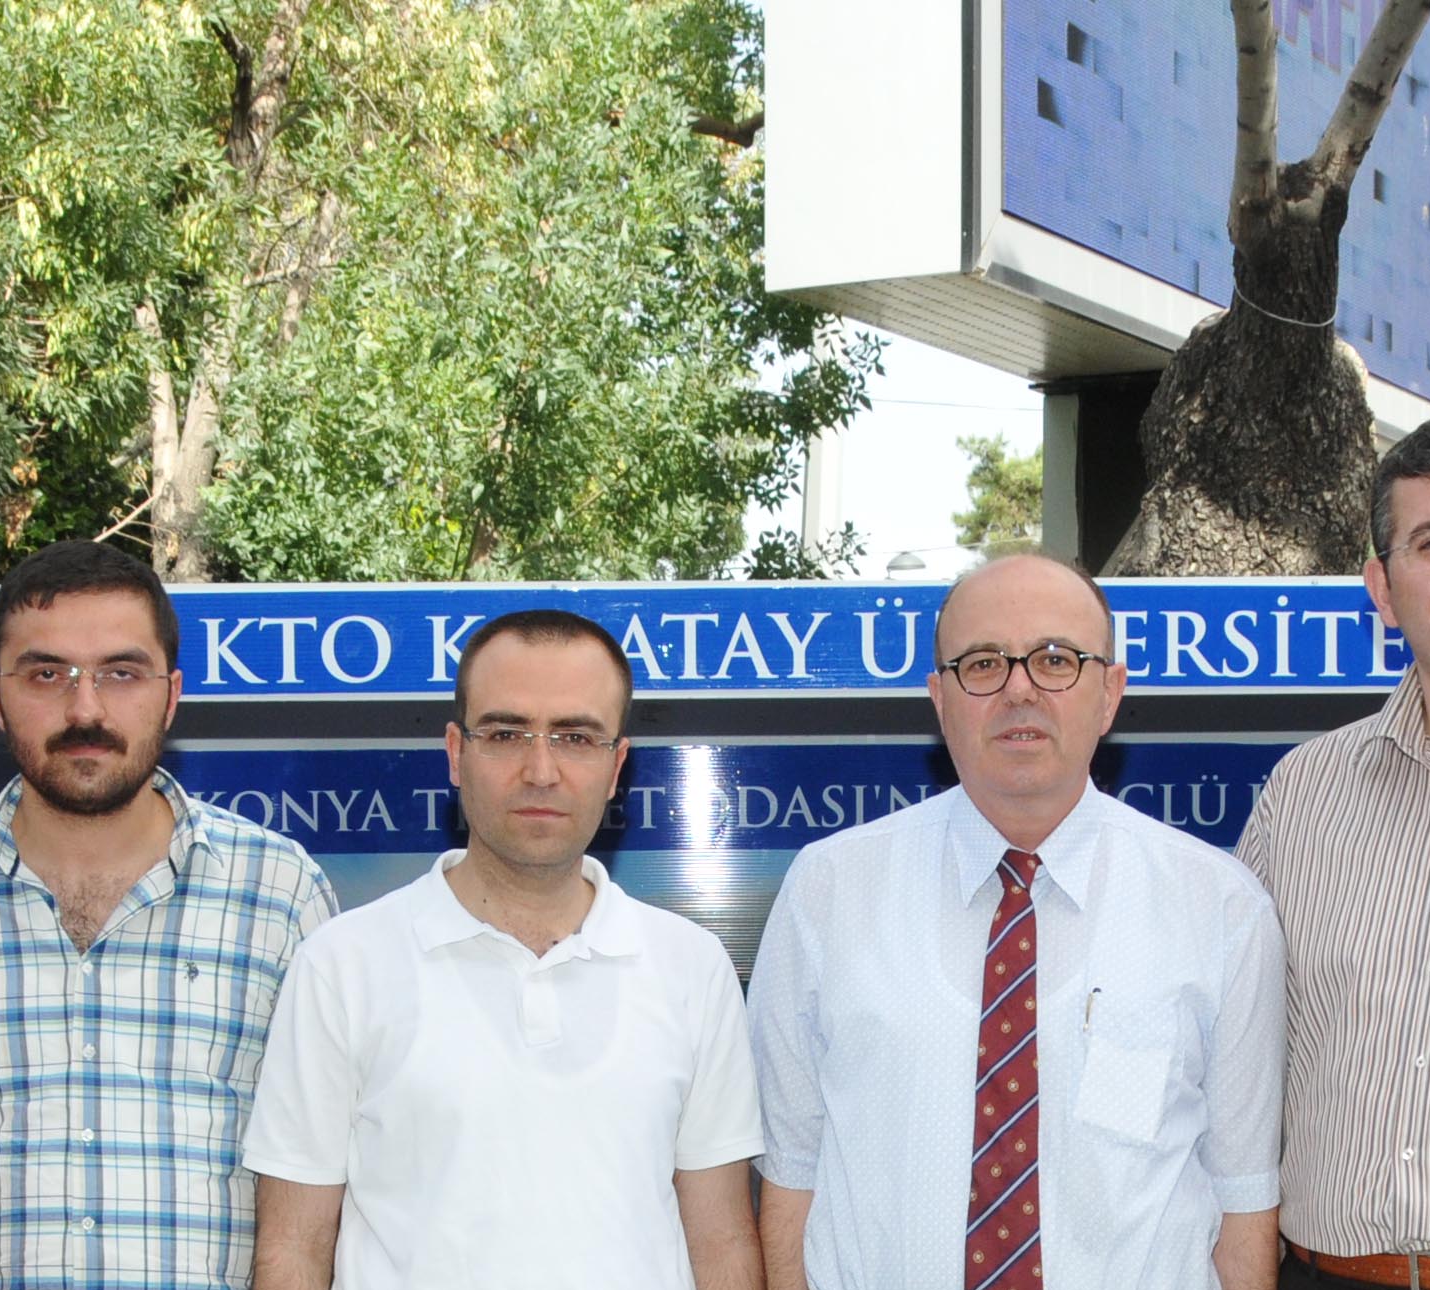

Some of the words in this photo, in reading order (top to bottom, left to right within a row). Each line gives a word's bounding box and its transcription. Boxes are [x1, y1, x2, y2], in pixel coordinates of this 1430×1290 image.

[198, 614, 393, 685] KTO
[424, 612, 832, 683] KATAY
[853, 595, 1409, 679] ÜERSİTE
